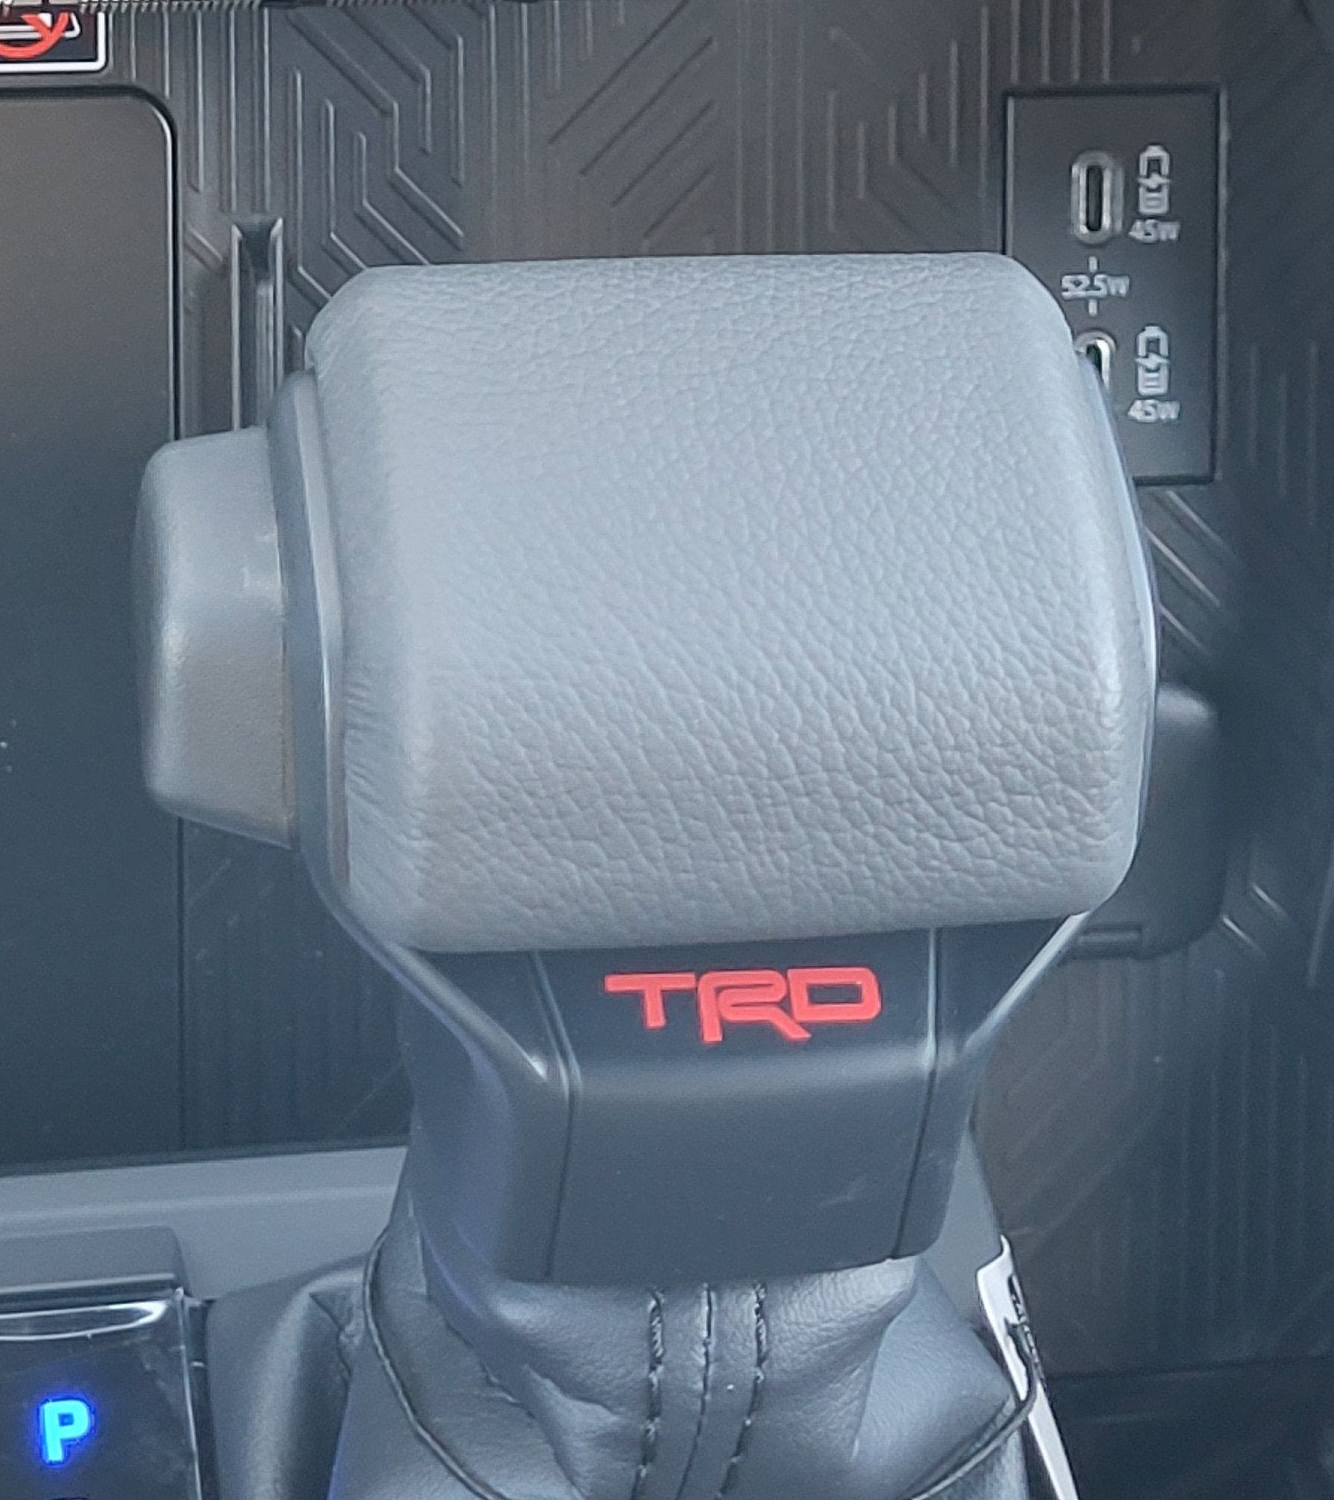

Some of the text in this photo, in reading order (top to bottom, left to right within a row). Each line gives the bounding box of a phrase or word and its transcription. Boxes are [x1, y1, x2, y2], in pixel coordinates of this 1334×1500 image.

[1127, 218, 1181, 244] 45W
[1127, 398, 1181, 424] 45W
[603, 965, 882, 1044] TRD
[39, 1399, 91, 1463] P
